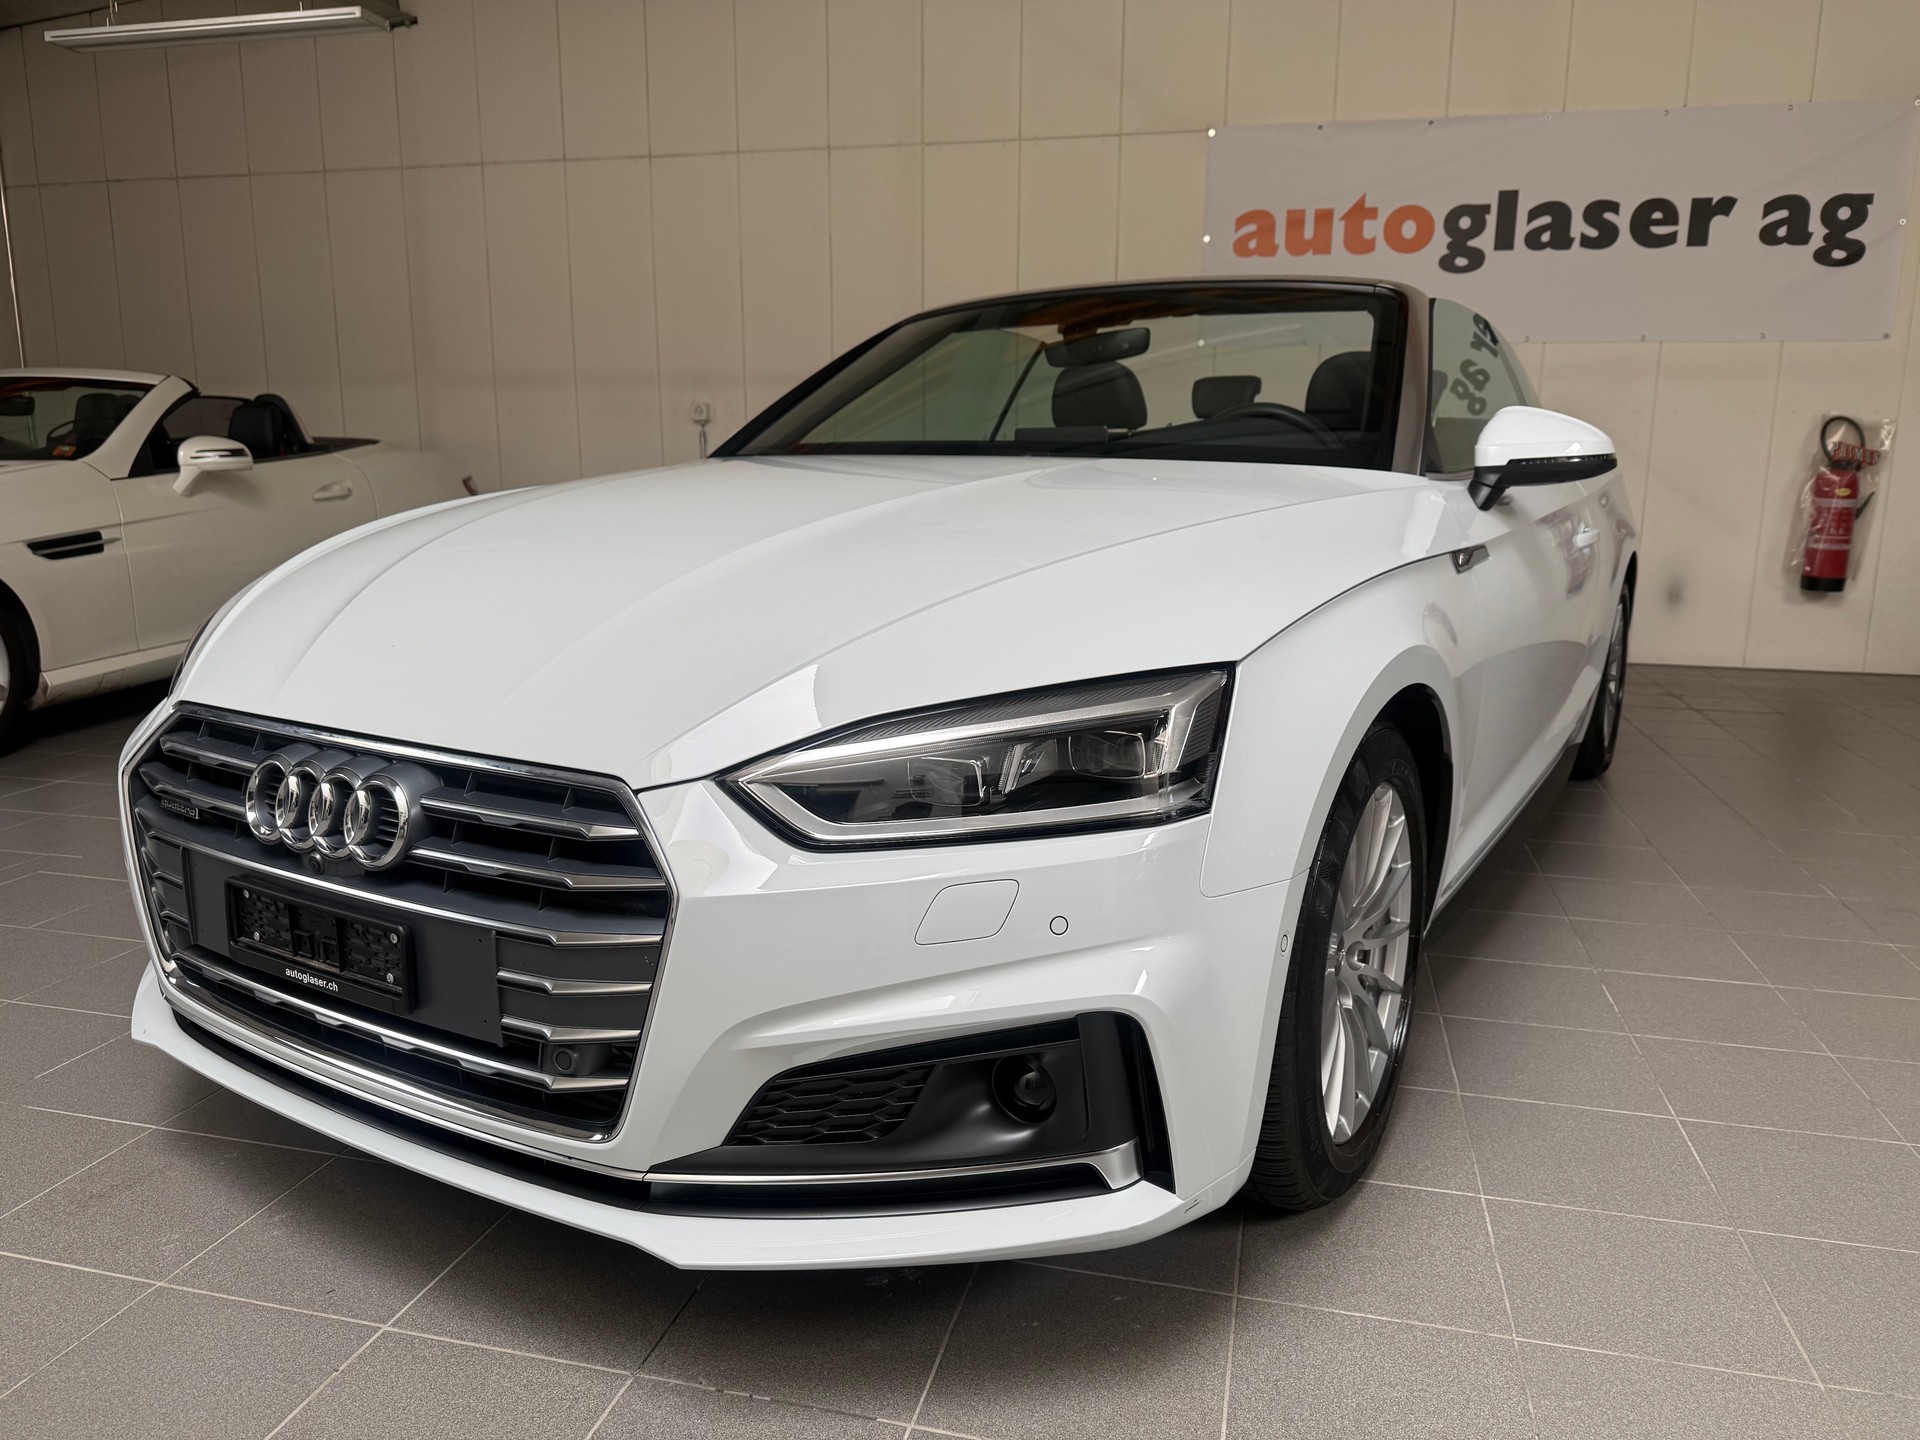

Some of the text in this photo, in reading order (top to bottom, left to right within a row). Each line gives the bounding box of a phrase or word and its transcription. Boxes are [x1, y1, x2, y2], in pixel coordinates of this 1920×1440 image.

[1232, 190, 1875, 274] autoglaser ag
[1831, 441, 1881, 465] PRIMUS
[161, 799, 197, 817] quattro
[285, 968, 339, 992] autoglaser.ch
